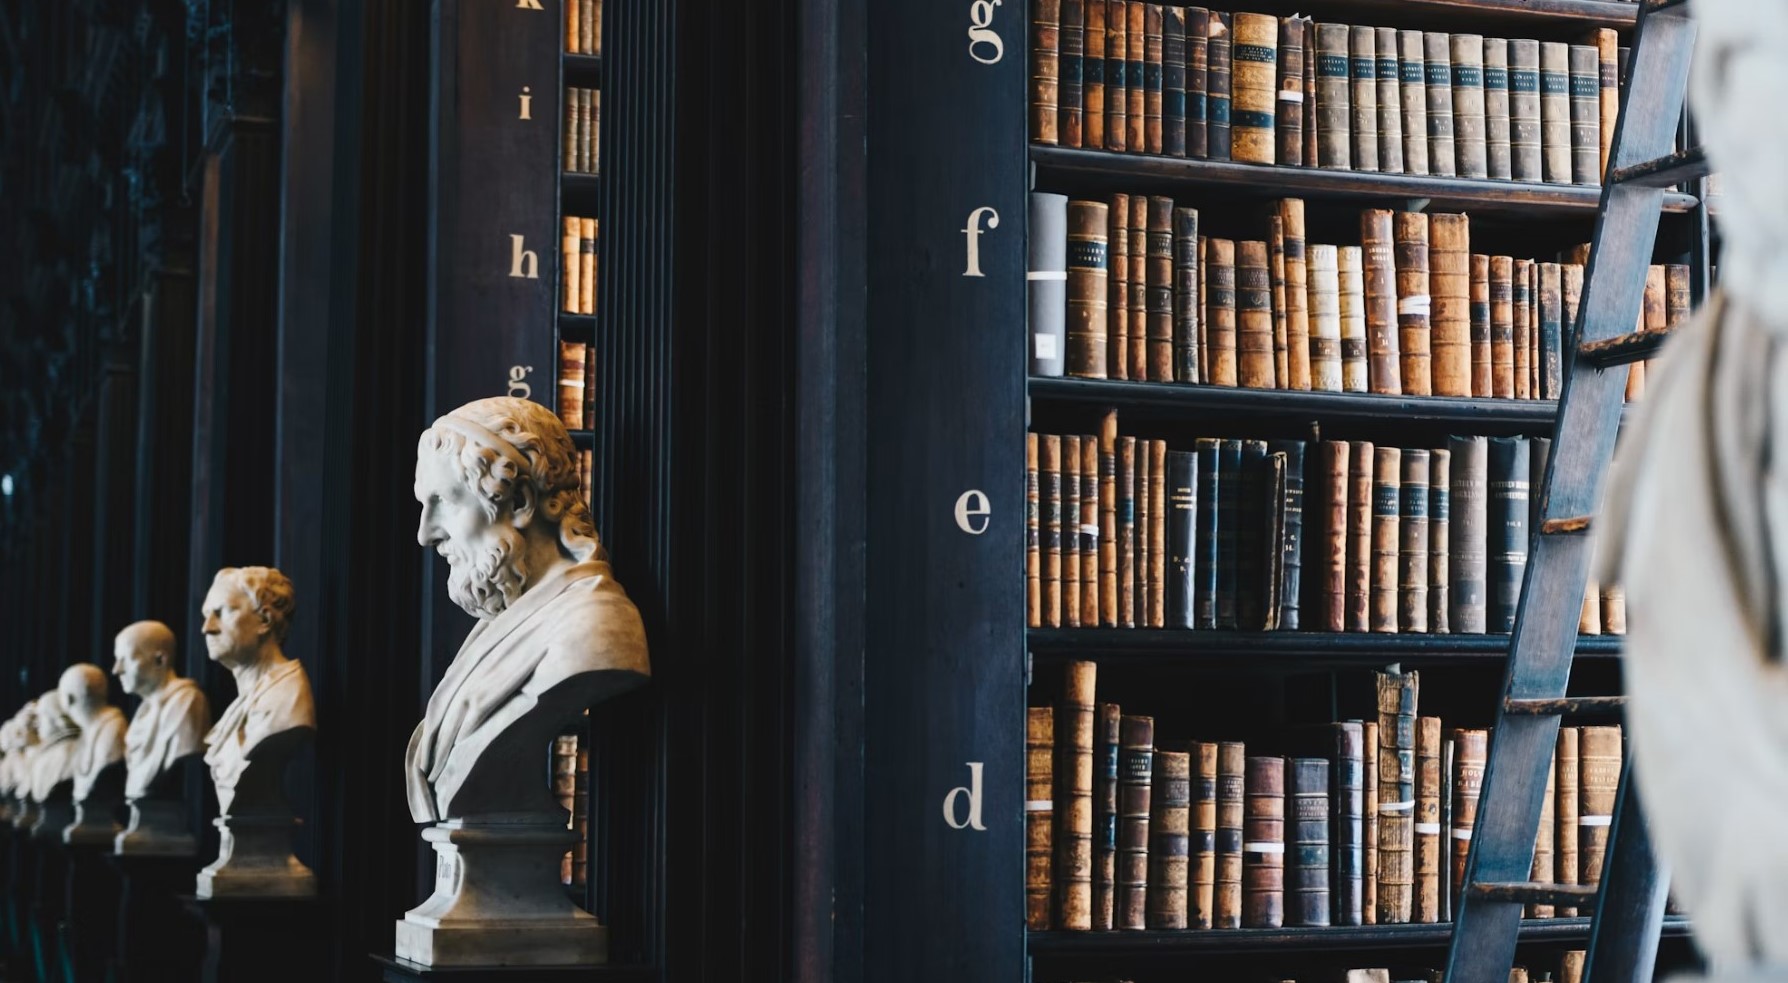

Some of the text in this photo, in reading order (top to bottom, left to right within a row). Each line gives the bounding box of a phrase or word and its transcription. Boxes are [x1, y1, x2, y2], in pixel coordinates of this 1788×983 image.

[968, 0, 1004, 65] g
[518, 86, 532, 120] i
[508, 234, 539, 279] h
[960, 206, 1000, 277] f
[507, 365, 533, 398] g
[954, 489, 992, 535] e
[942, 762, 987, 831] d
